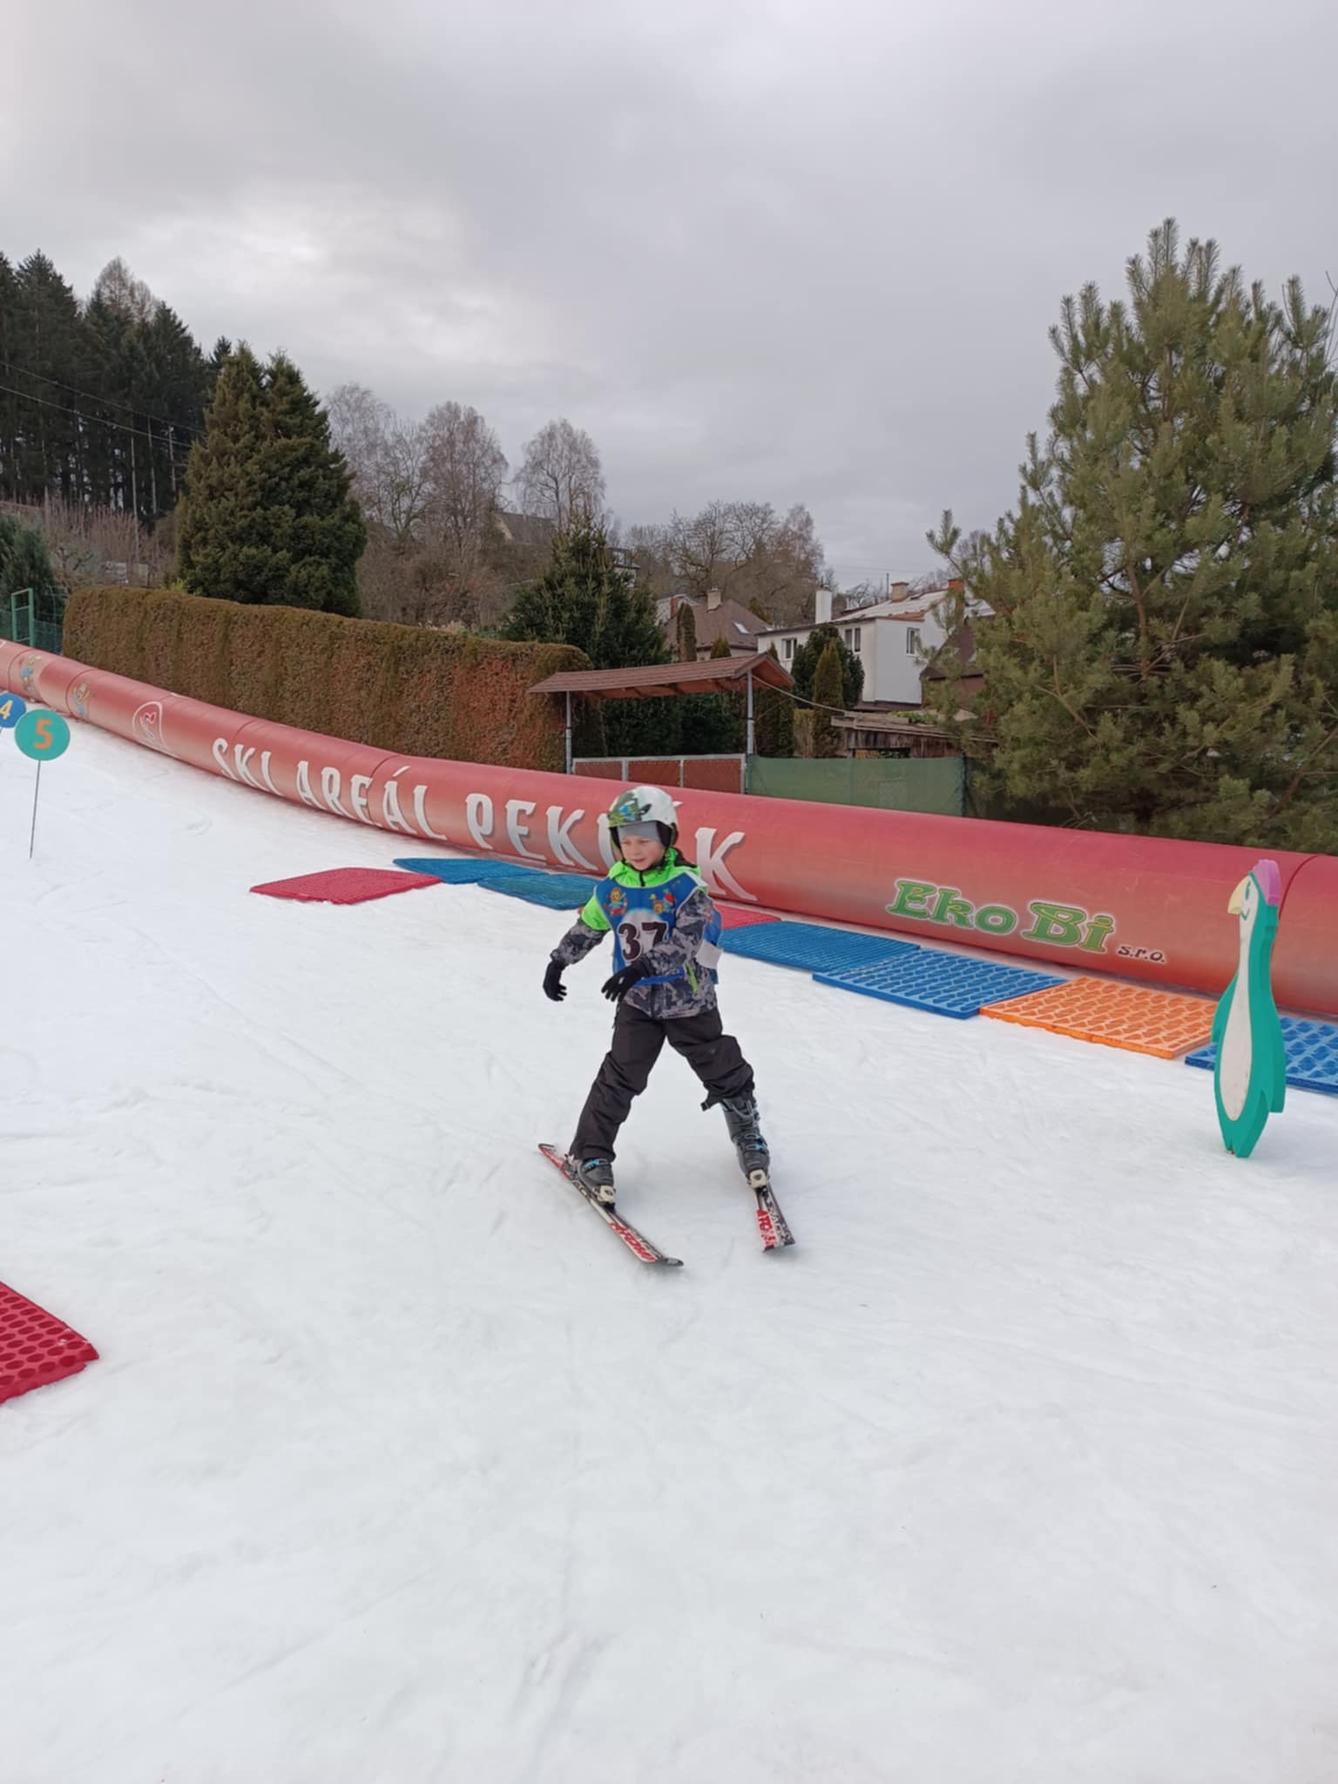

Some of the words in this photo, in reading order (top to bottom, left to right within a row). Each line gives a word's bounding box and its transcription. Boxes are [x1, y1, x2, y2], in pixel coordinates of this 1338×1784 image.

[0, 699, 13, 720] 4
[35, 718, 52, 749] 5
[212, 738, 284, 798] SKI
[296, 761, 448, 841] AREÁL
[465, 793, 758, 901] PEKK
[617, 920, 670, 962] 37
[887, 879, 1018, 936] Eko
[1020, 899, 1115, 953] Bi
[1117, 945, 1167, 964] s.r.o.
